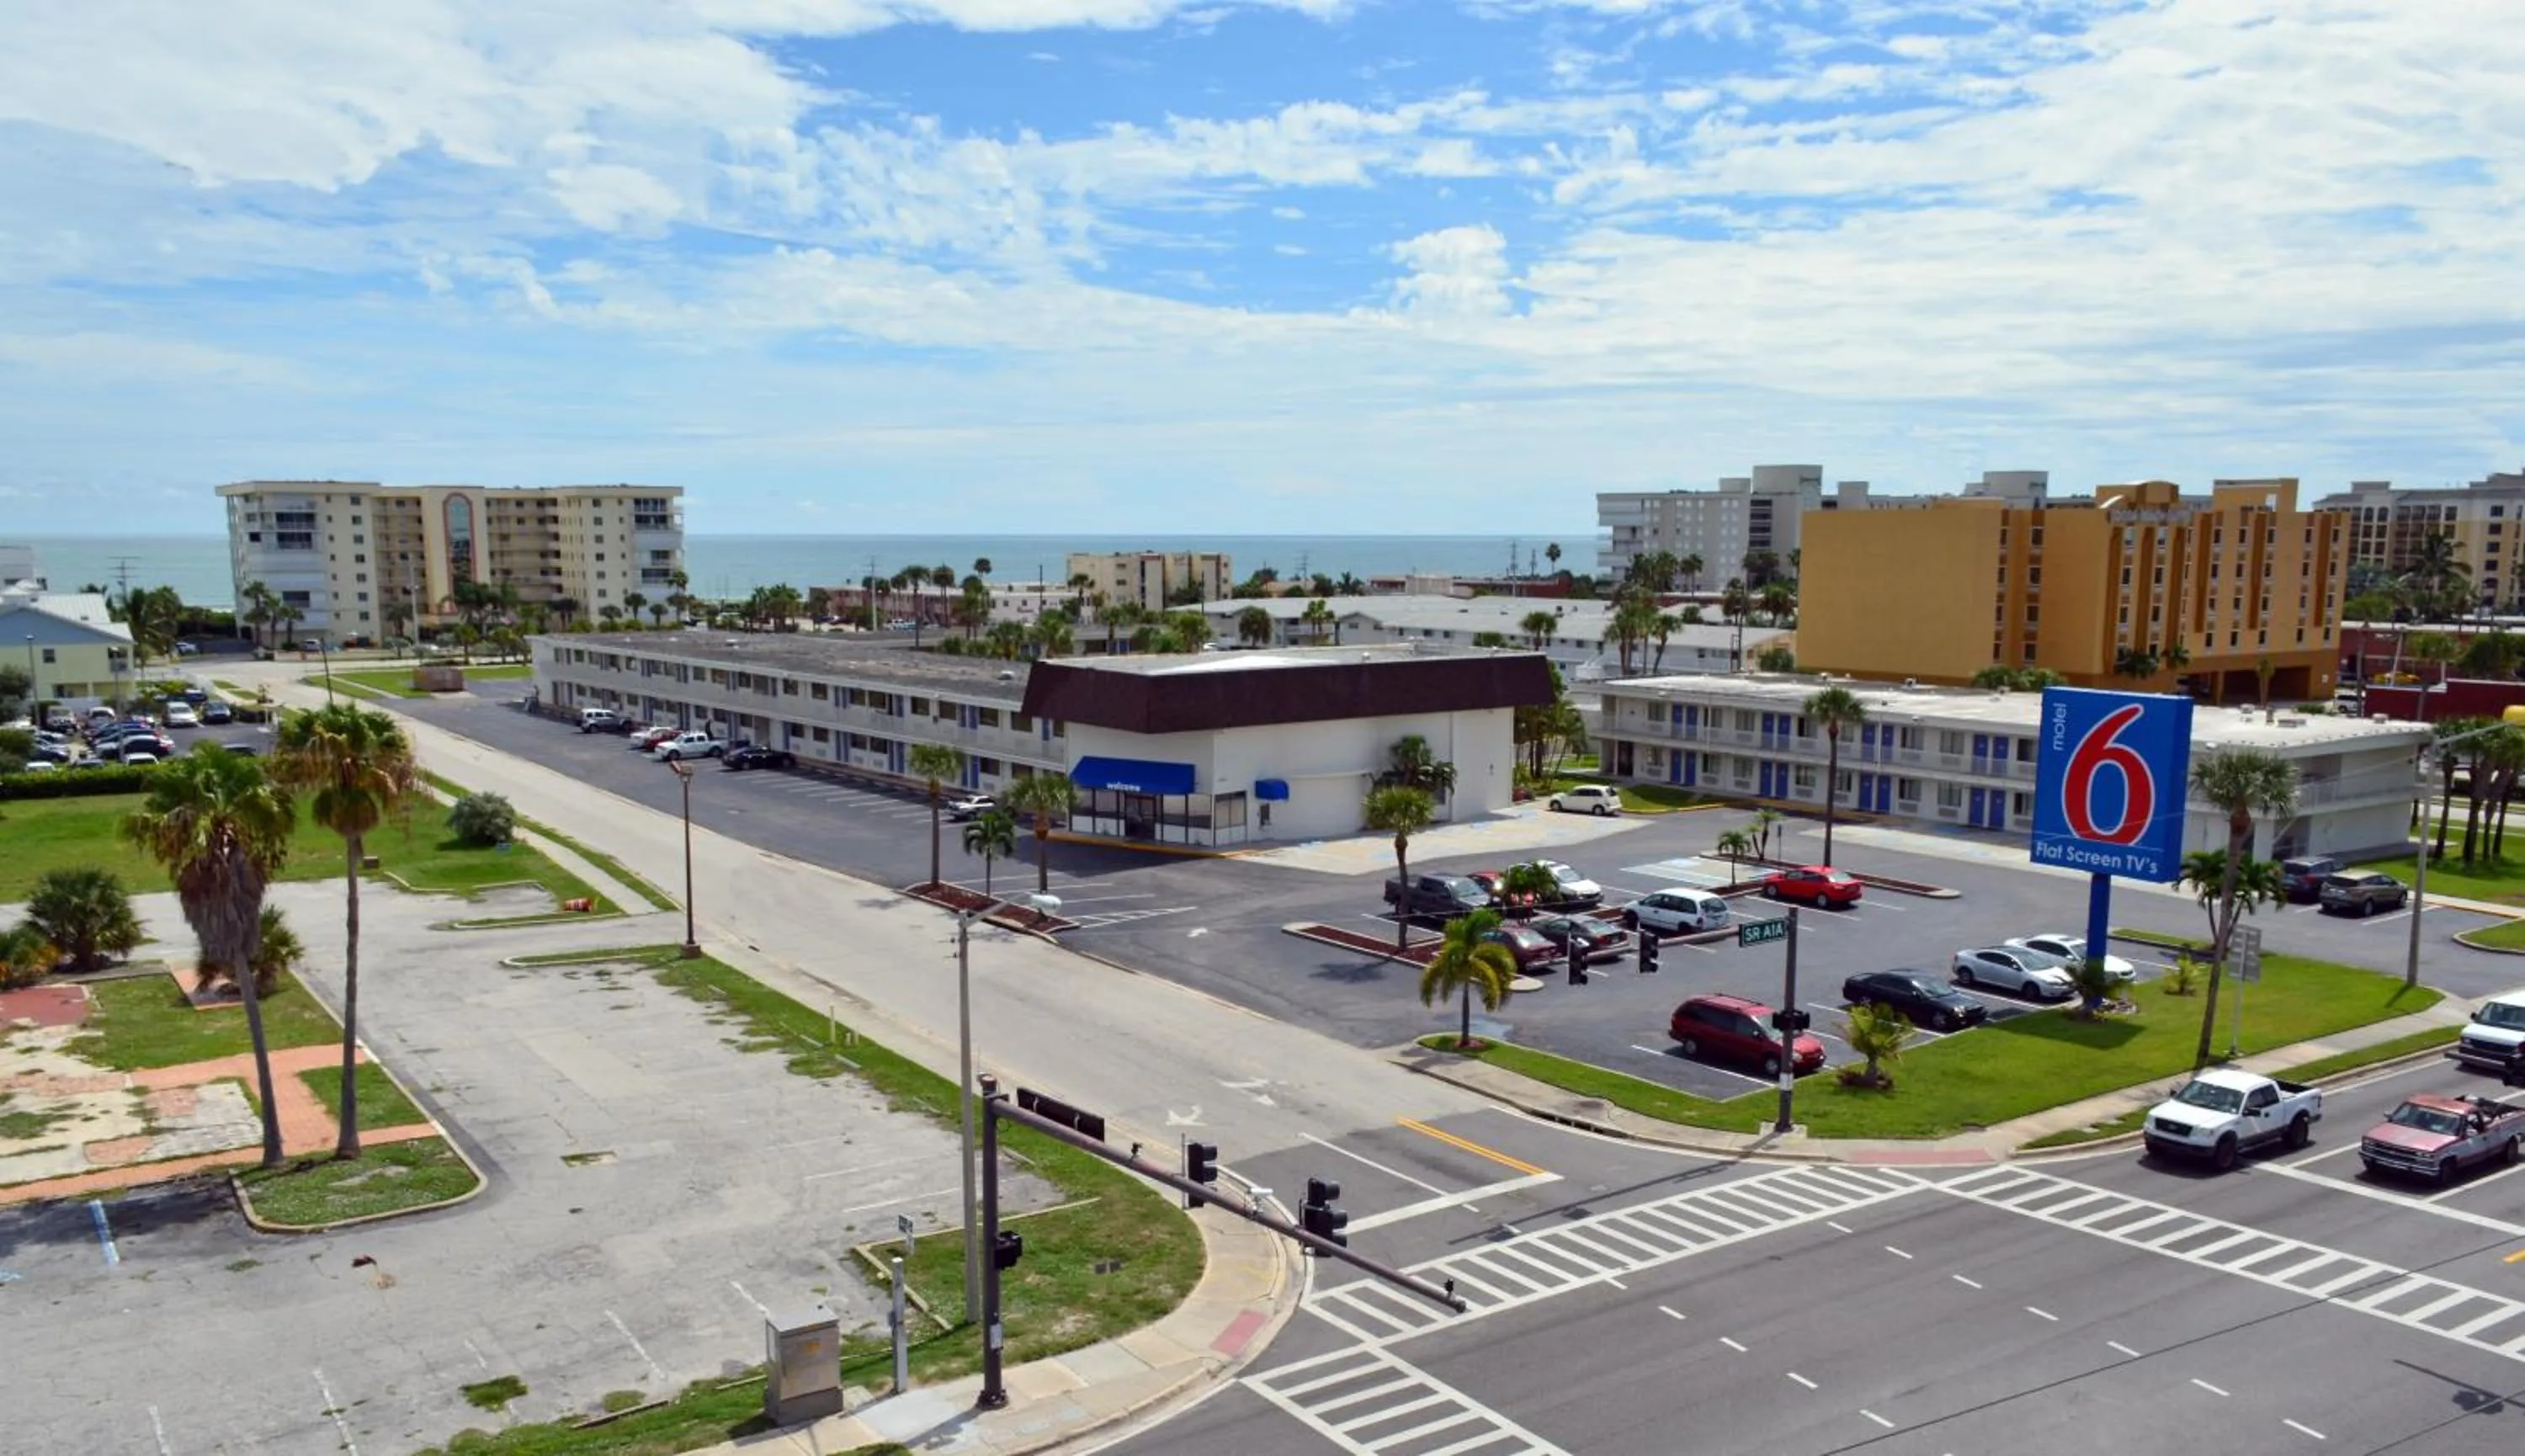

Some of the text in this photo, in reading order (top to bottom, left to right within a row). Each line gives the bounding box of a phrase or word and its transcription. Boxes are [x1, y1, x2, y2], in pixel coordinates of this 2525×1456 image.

[2052, 702, 2068, 752] motel
[2061, 703, 2156, 847] 6
[2035, 842, 2158, 875] Flat Screen TV's
[1745, 922, 1783, 942] SR A1A
